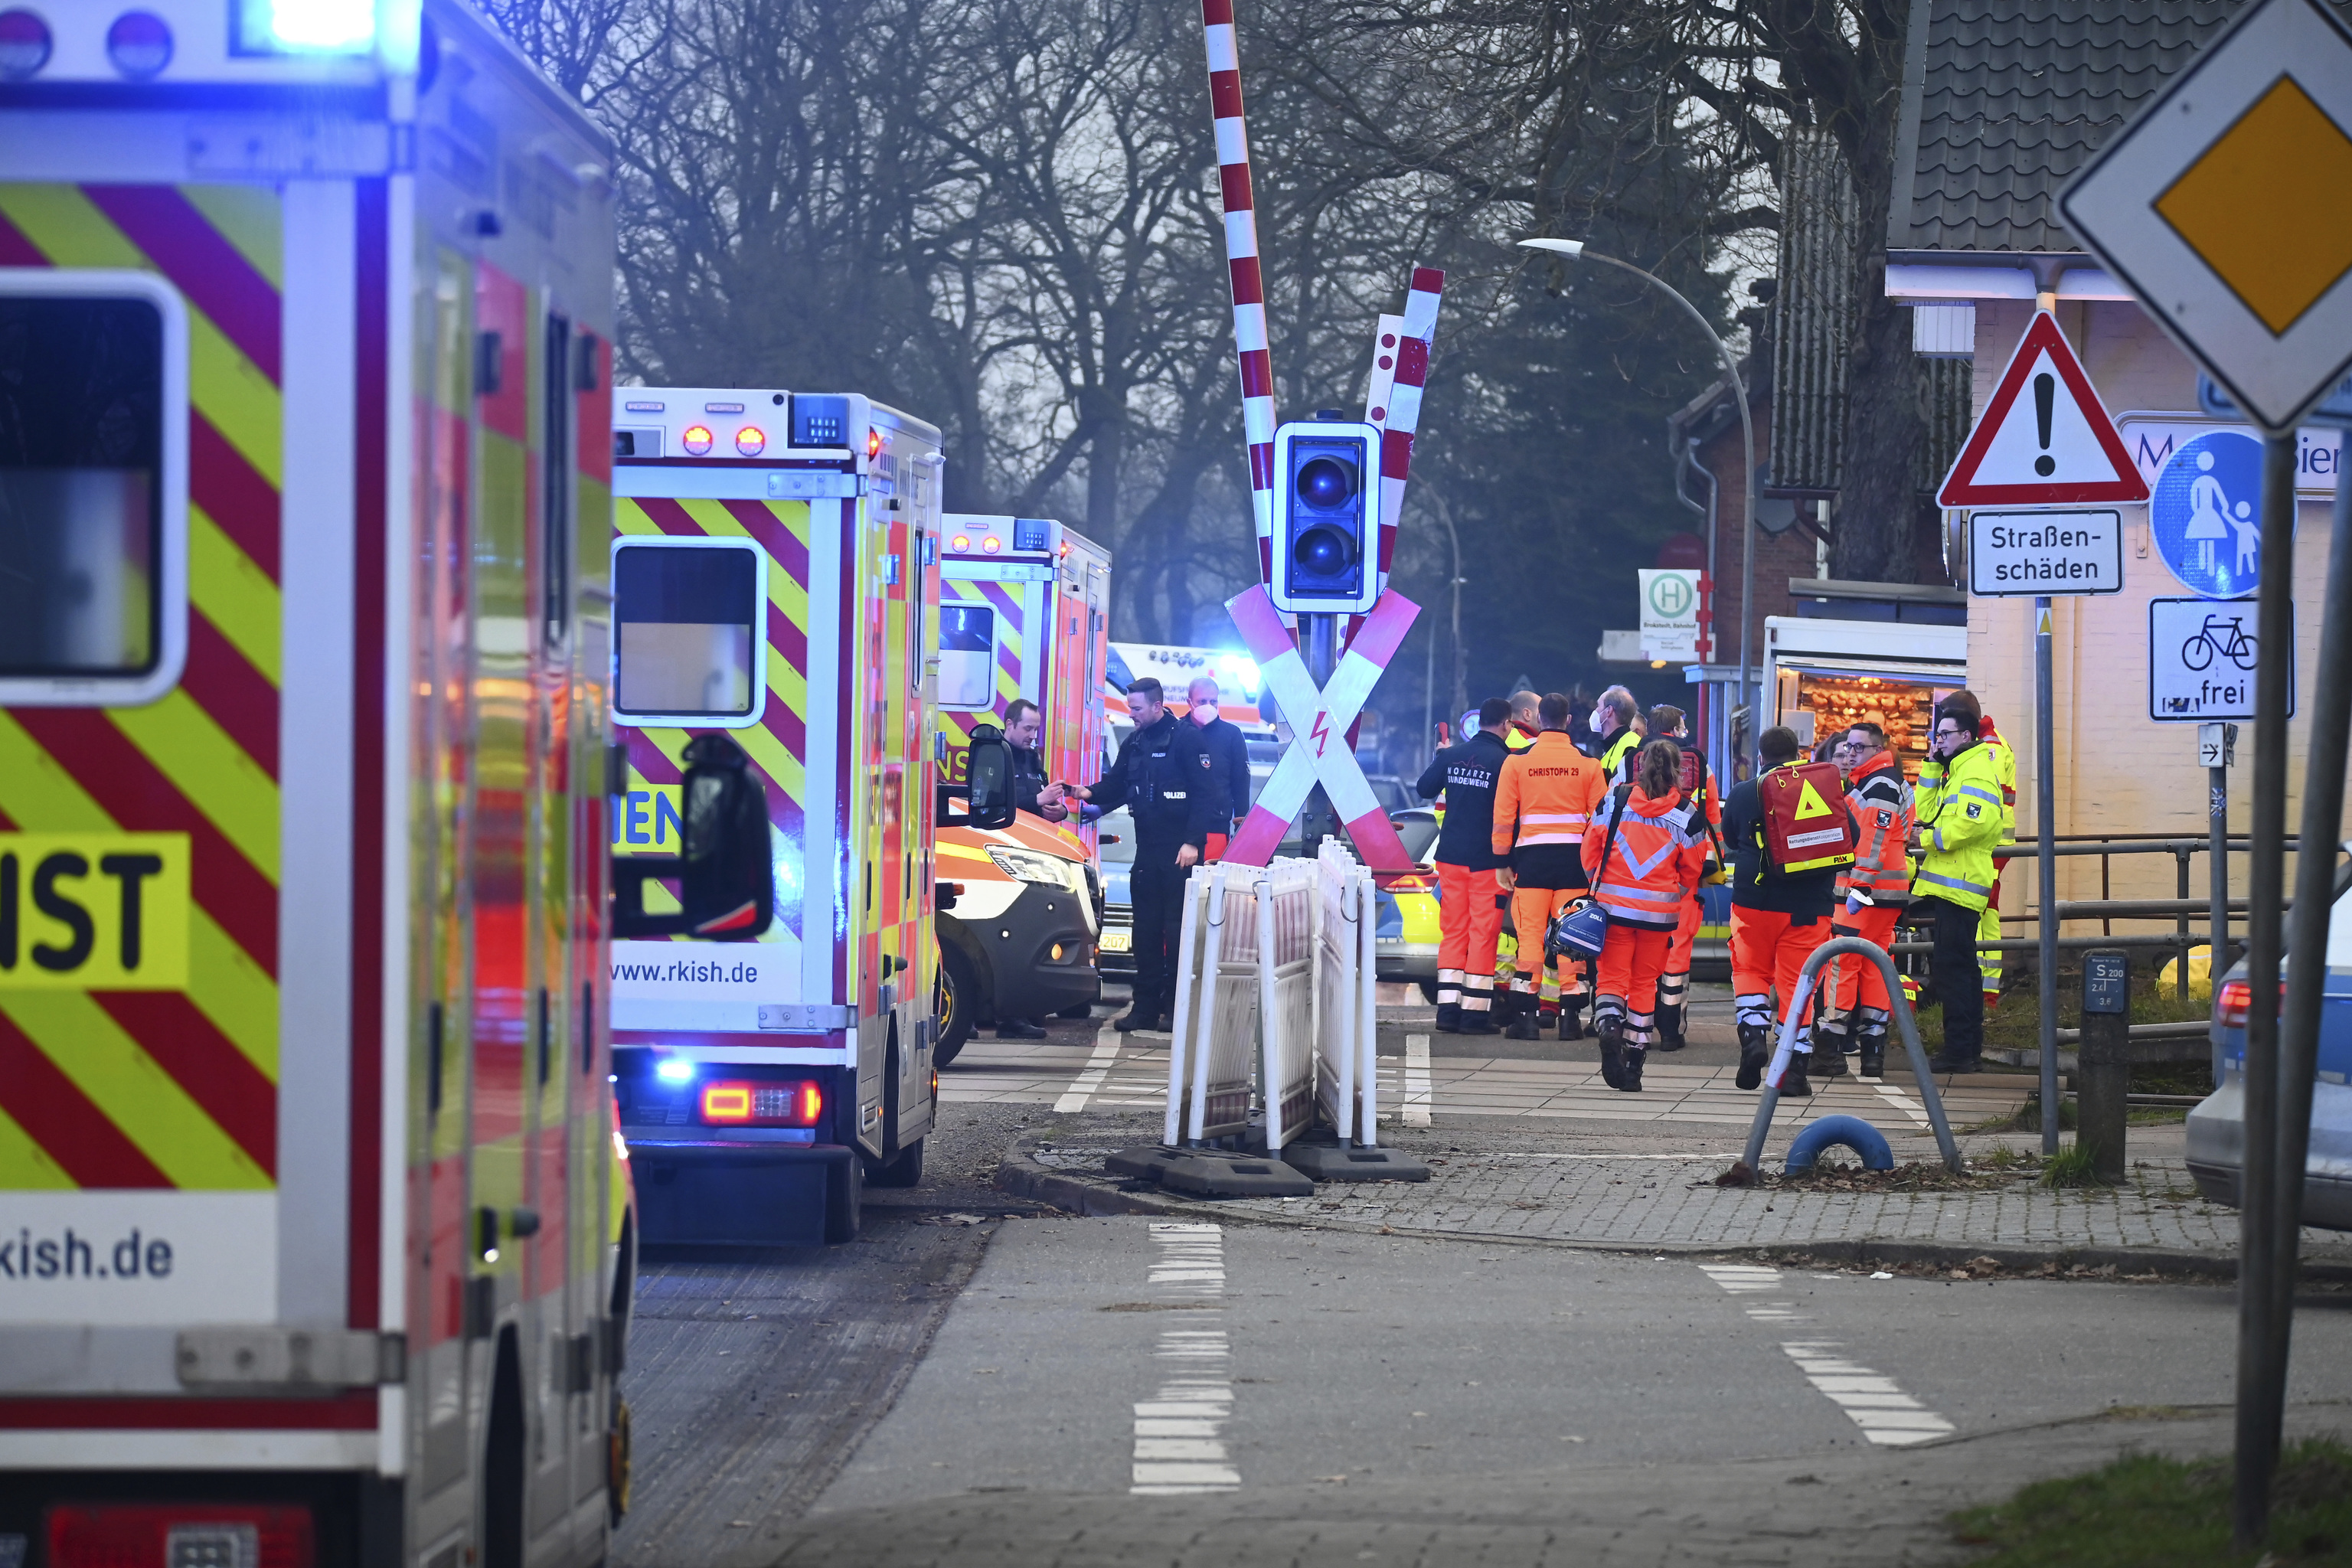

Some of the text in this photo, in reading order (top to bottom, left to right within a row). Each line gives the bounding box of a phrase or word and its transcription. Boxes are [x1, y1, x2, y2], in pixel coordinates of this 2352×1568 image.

[1991, 525, 2101, 549] Straßen-
[1996, 557, 2098, 581] schäden
[2201, 679, 2244, 704] frei
[1447, 766, 1491, 780] NOTARZT
[1528, 767, 1579, 777] CHRISTOPH 29
[1589, 913, 1603, 923] ZOLL
[2096, 964, 2123, 977] S 200
